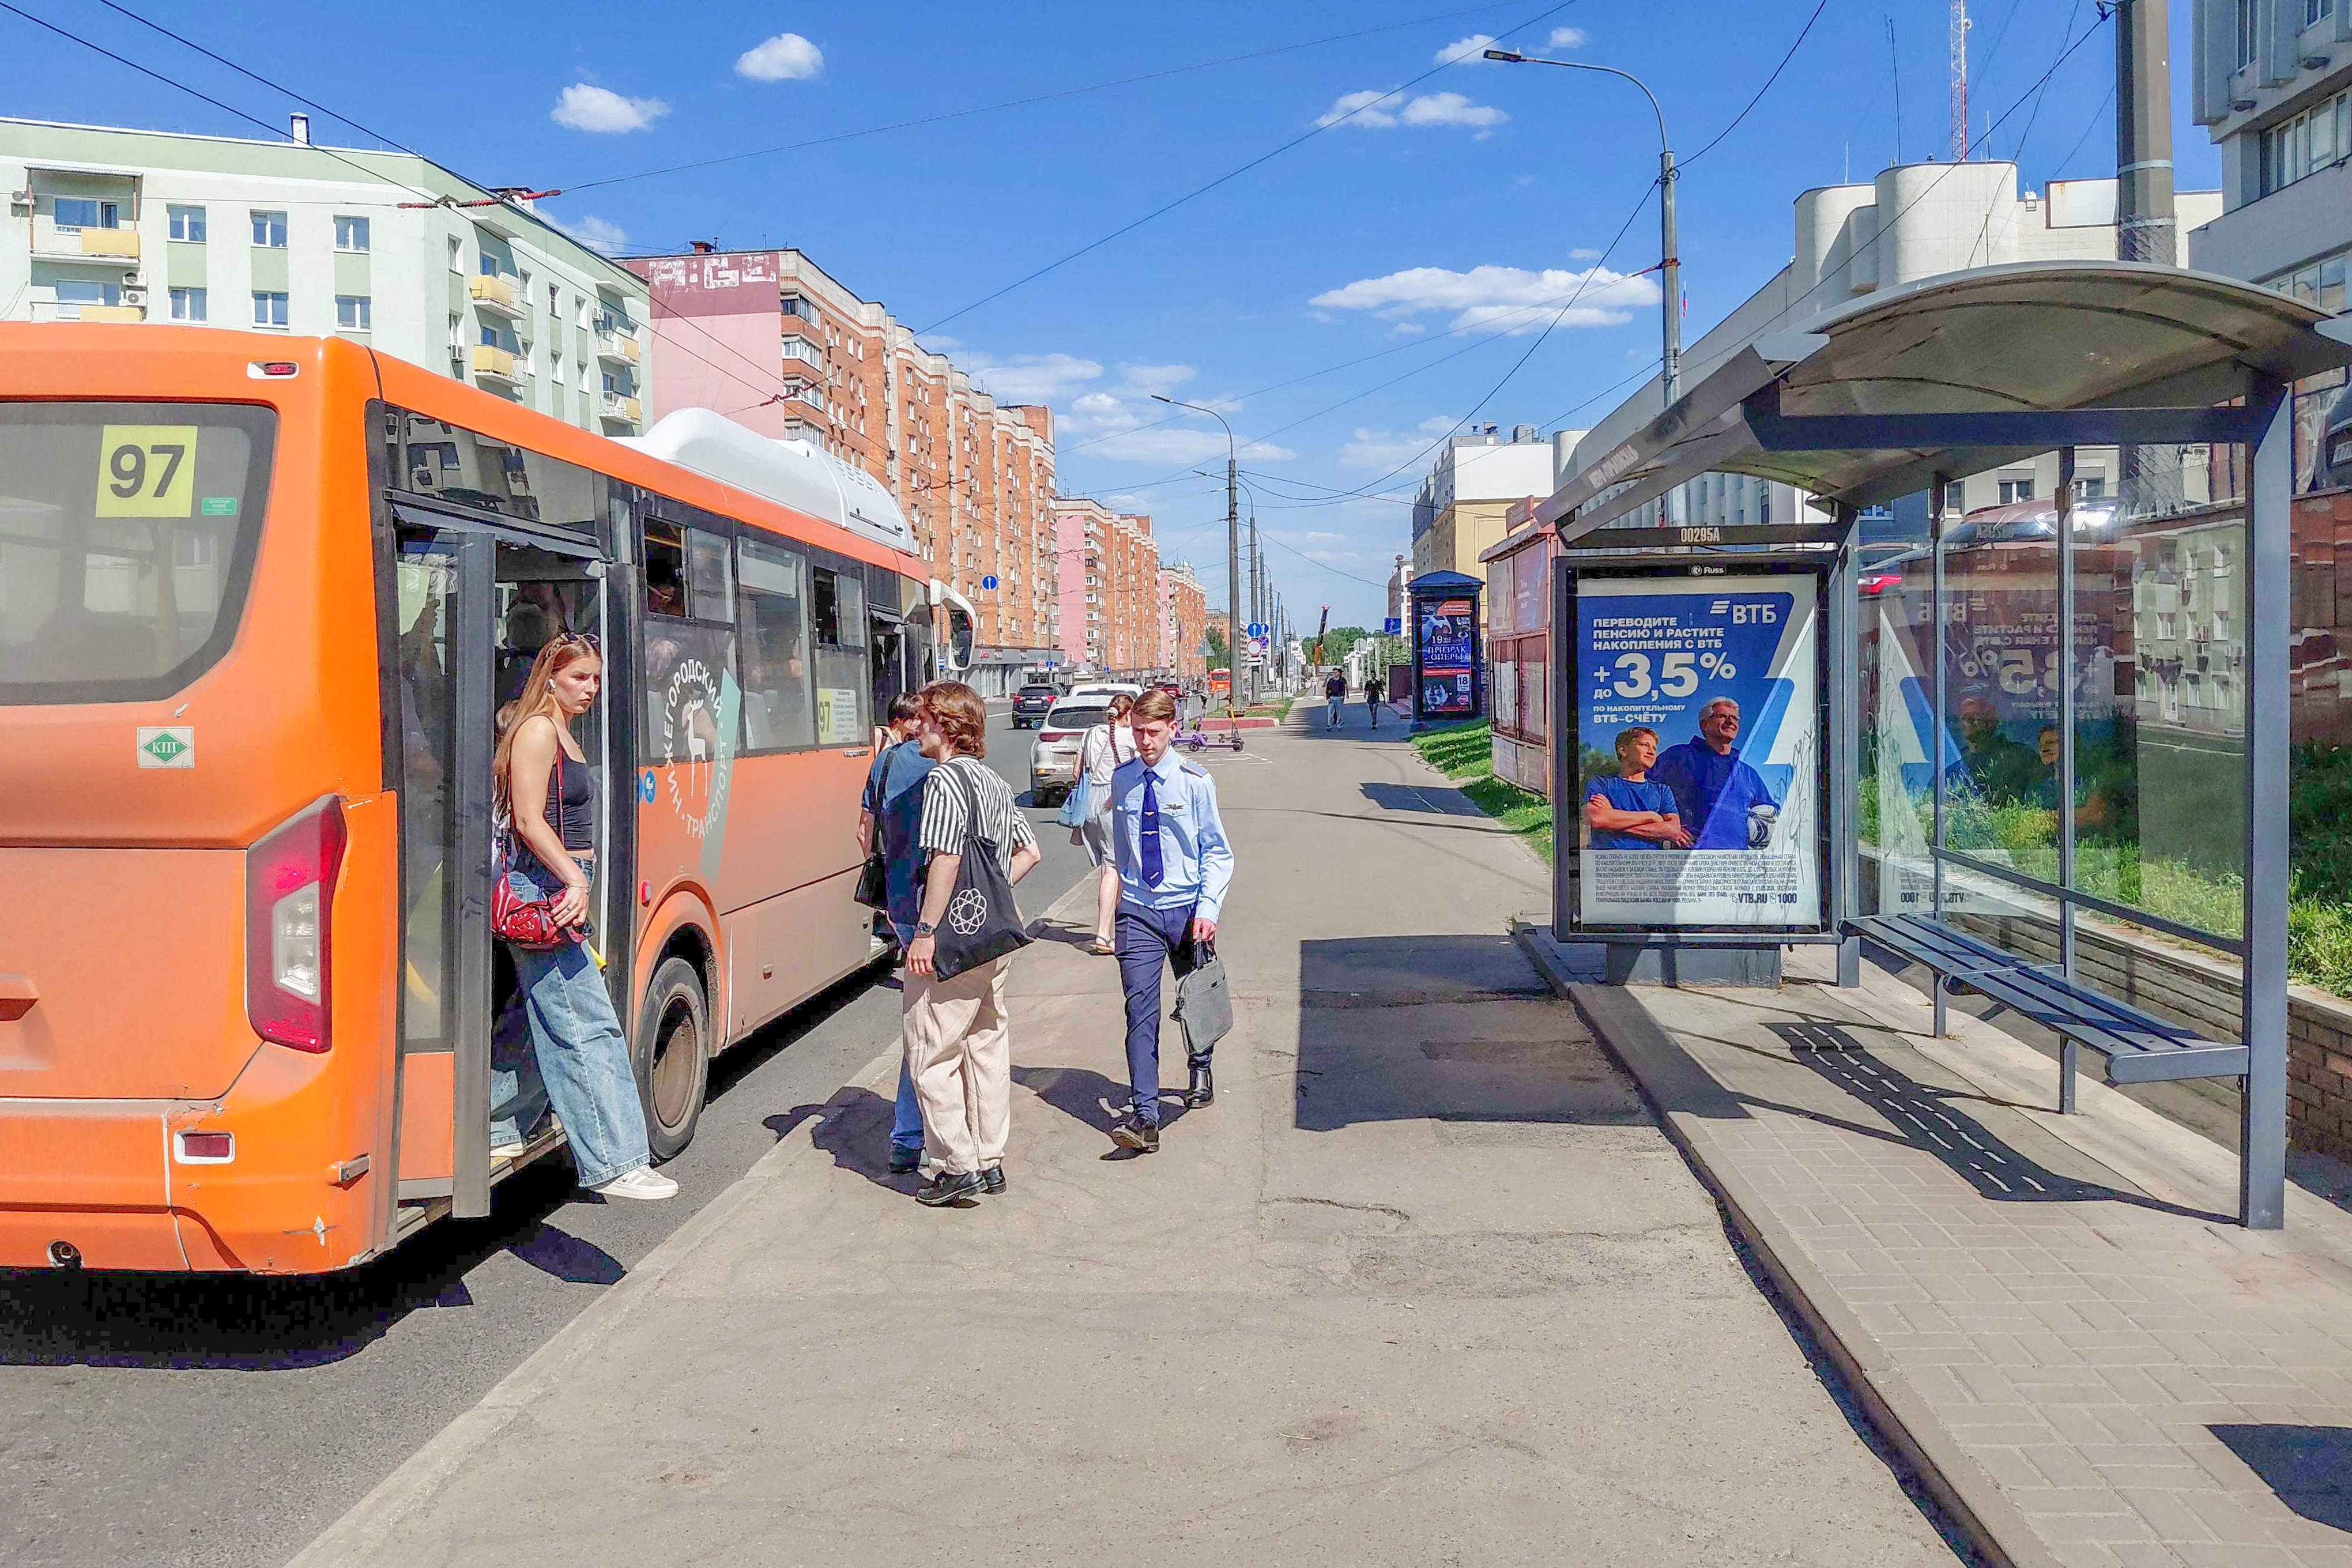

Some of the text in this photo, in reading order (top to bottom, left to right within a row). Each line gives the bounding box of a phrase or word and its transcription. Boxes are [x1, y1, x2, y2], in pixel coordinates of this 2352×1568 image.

[110, 444, 185, 498] 97
[1680, 527, 1720, 542] 00295A
[1732, 604, 1777, 624] ВТБ
[1593, 617, 1677, 628] ПЕРЕВОДИТЕ
[1432, 635, 1443, 644] 19
[1593, 628, 1724, 639] ПЕНСИЮ И РАСТИТЕ
[1593, 639, 1722, 651] НАКОПЛЕНИЯ С ВТБ
[1458, 677, 1468, 685] 18
[819, 701, 830, 733] 97
[1593, 713, 1666, 723] ВТБ-СЧЁТУ
[152, 741, 179, 753] КПГ
[664, 659, 727, 839] НИЖЕГОРОДСКИЙ ТРАНСПОРТ
[1738, 893, 1797, 903] VTB.RU 1000
